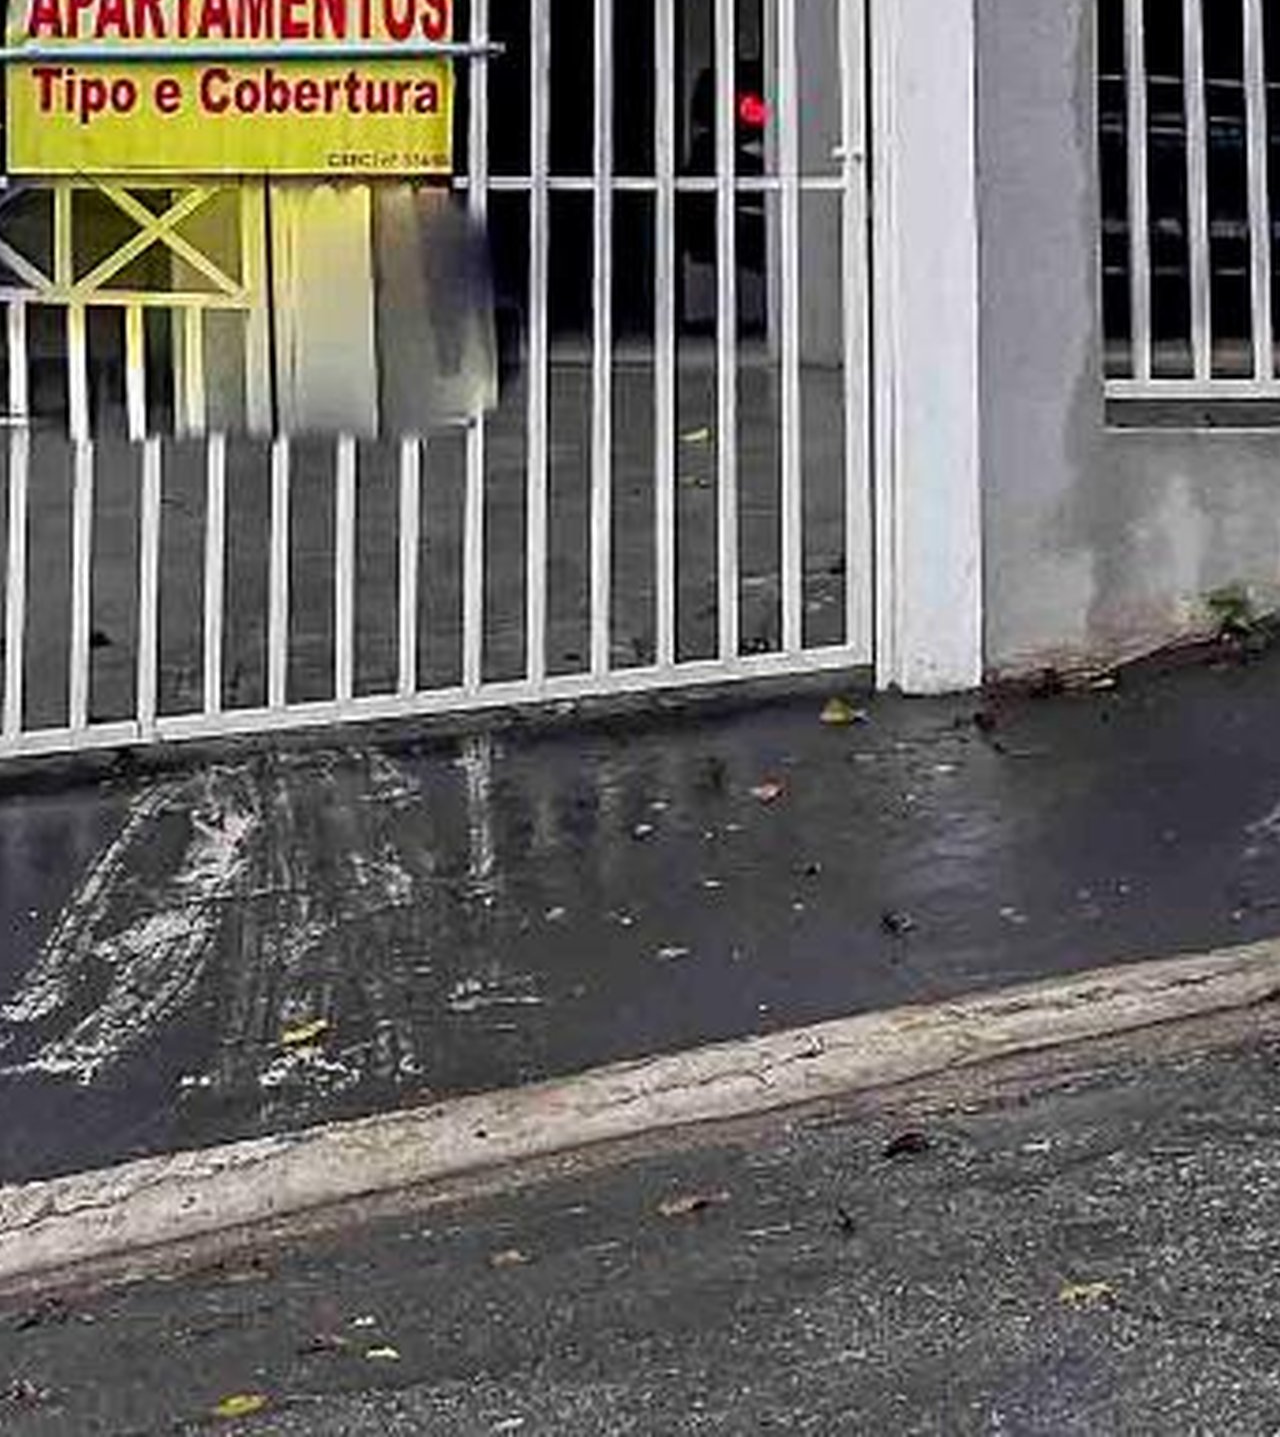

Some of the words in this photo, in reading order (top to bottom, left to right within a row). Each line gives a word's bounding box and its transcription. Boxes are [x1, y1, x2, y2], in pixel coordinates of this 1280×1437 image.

[32, 68, 137, 124] Tipo
[155, 80, 183, 114] e
[200, 68, 439, 116] Cobertura
